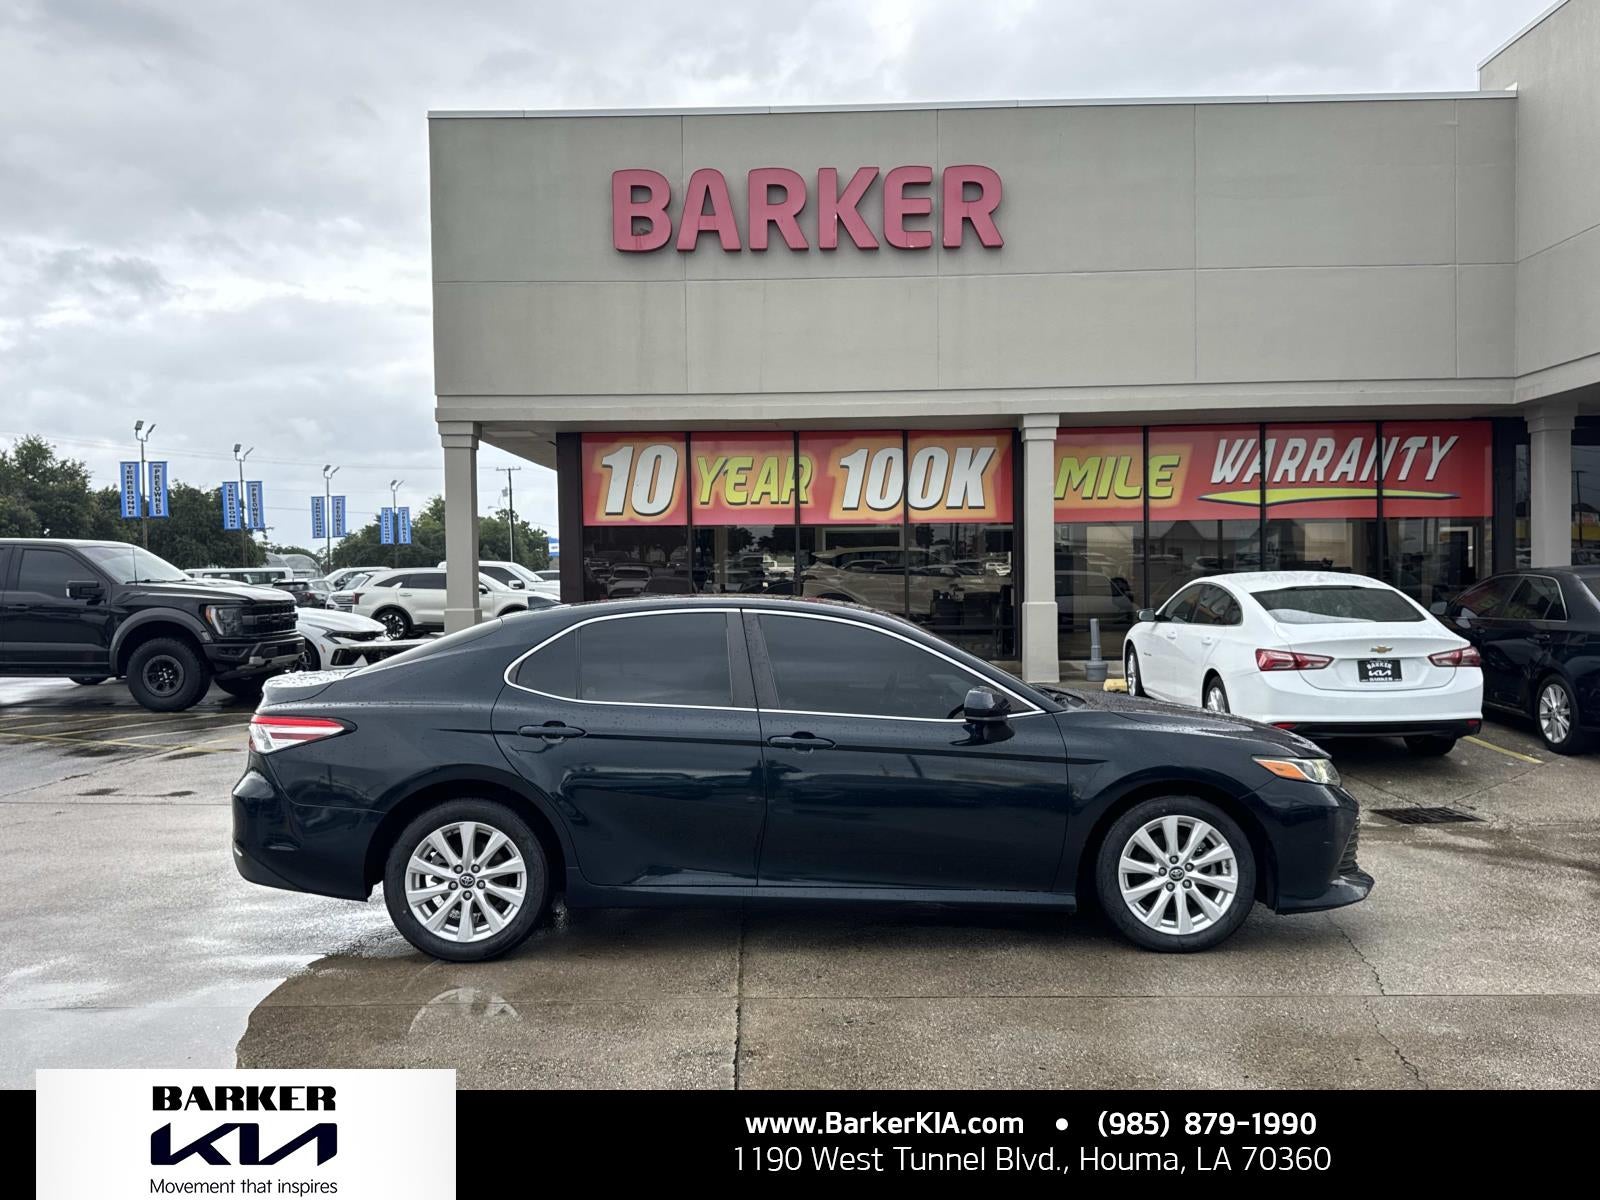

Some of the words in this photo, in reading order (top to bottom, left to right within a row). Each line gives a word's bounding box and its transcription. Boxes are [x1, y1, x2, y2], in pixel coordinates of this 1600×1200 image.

[612, 165, 1004, 252] BARKER
[126, 465, 135, 515] TERREBONNE
[602, 443, 679, 516] 10
[697, 456, 813, 505] YEAR
[839, 447, 997, 511] 100K
[1054, 455, 1181, 500] MILE
[1210, 435, 1459, 484] WARRANTY
